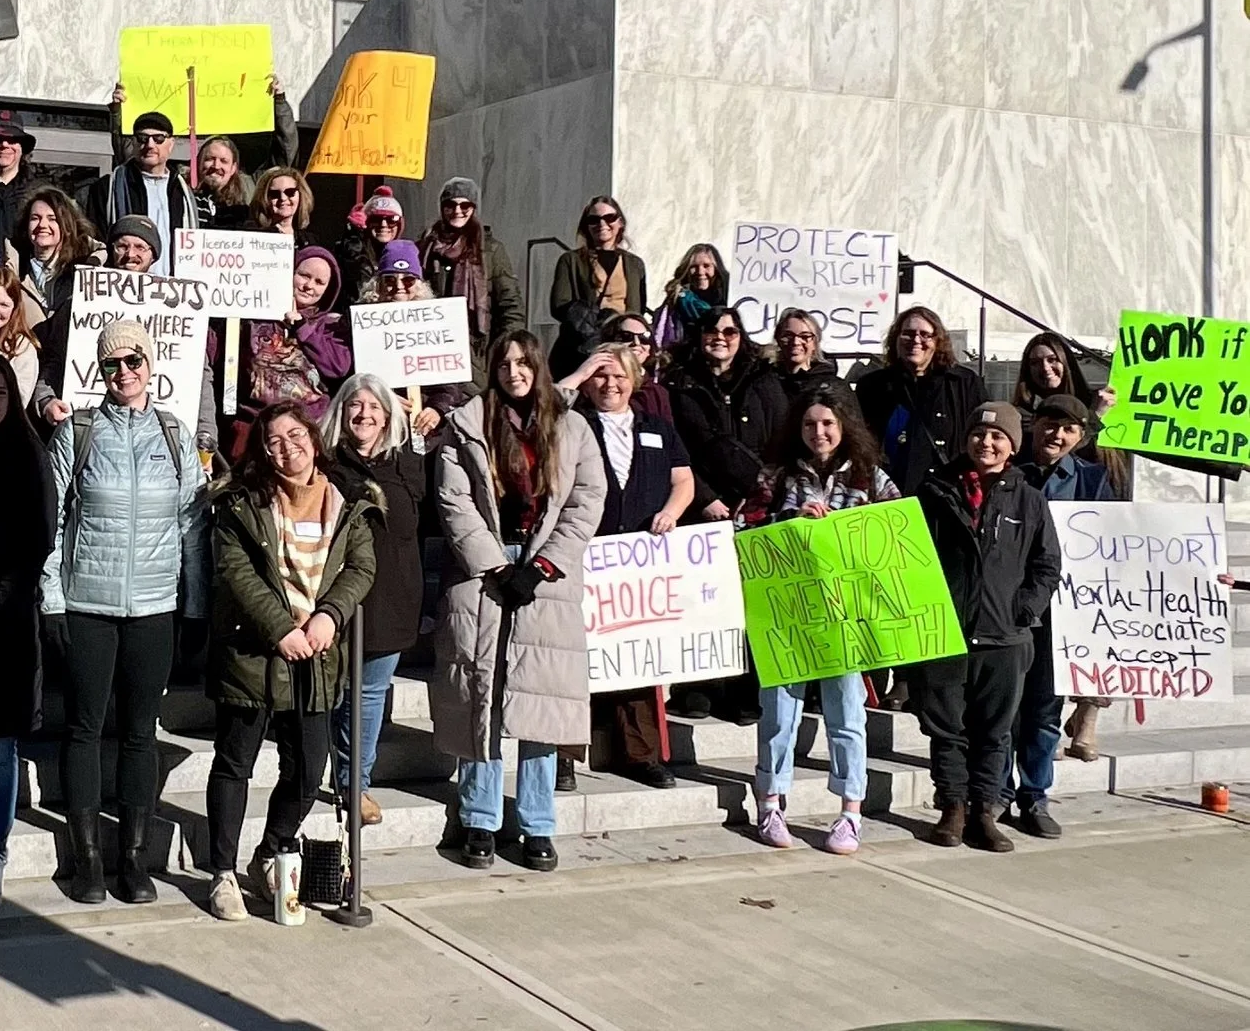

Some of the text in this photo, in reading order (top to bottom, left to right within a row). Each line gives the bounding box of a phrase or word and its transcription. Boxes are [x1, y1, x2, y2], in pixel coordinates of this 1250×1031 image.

[179, 231, 195, 250] 15
[202, 233, 244, 250] licensed
[734, 224, 894, 262] PROTECT
[178, 254, 196, 264] per
[200, 252, 245, 269] 10,000
[735, 256, 893, 290] YOUR RIGHT
[76, 267, 208, 311] THERAPISTS
[219, 272, 252, 286] NOT
[794, 286, 816, 298] TO
[210, 288, 270, 309] OUGH!
[352, 306, 445, 330] ASSOCIATES
[383, 329, 455, 350] DESERVE
[1221, 327, 1248, 359] if
[403, 353, 466, 376] BETTER
[1218, 380, 1250, 416] Yo
[1133, 412, 1250, 459] Therap
[687, 531, 721, 565] OF
[833, 506, 932, 572] FOR
[765, 566, 929, 630] MENTAL
[766, 602, 946, 679] HEALTH
[587, 637, 672, 680] ENTAL
[1069, 661, 1213, 698] MEDICAID
